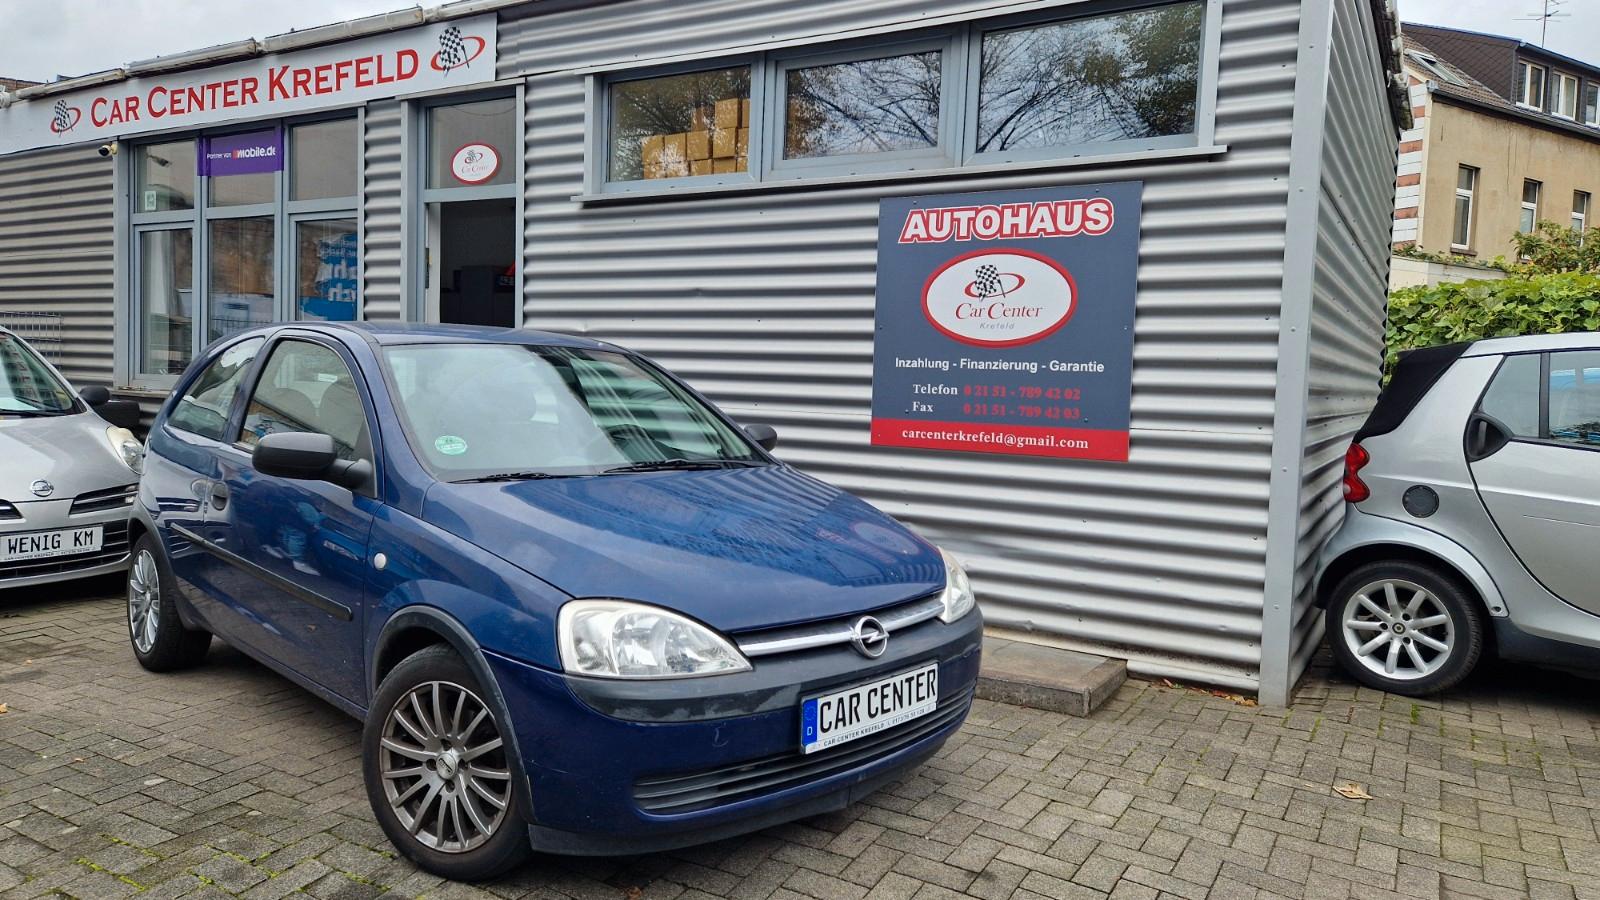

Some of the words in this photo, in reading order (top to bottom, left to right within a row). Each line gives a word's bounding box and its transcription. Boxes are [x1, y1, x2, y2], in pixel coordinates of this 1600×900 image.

[90, 95, 141, 128] CAR
[147, 77, 259, 118] CENTER
[268, 48, 420, 102] KREFELD
[899, 197, 1114, 243] AUTOHAUS
[955, 302, 985, 320] Car
[987, 302, 1043, 320] Center
[979, 322, 1015, 330] Krefeld
[895, 357, 950, 371] Inzahlung
[959, 358, 1038, 374] Finanzierung
[1049, 360, 1105, 373] Garantie
[912, 383, 958, 395] Telefon
[963, 384, 972, 396] 0
[912, 401, 934, 412] Fax
[963, 402, 972, 416] 0
[902, 429, 1089, 449] carcenterkrefeld@gmail.com
[8, 533, 61, 555] WENIG
[73, 530, 94, 547] KM
[819, 692, 861, 734] CAR
[867, 668, 936, 719] CENTER
[806, 726, 813, 736] D
[823, 738, 836, 747] CAR
[837, 731, 860, 743] CENTER
[860, 723, 885, 735] KREFELD
